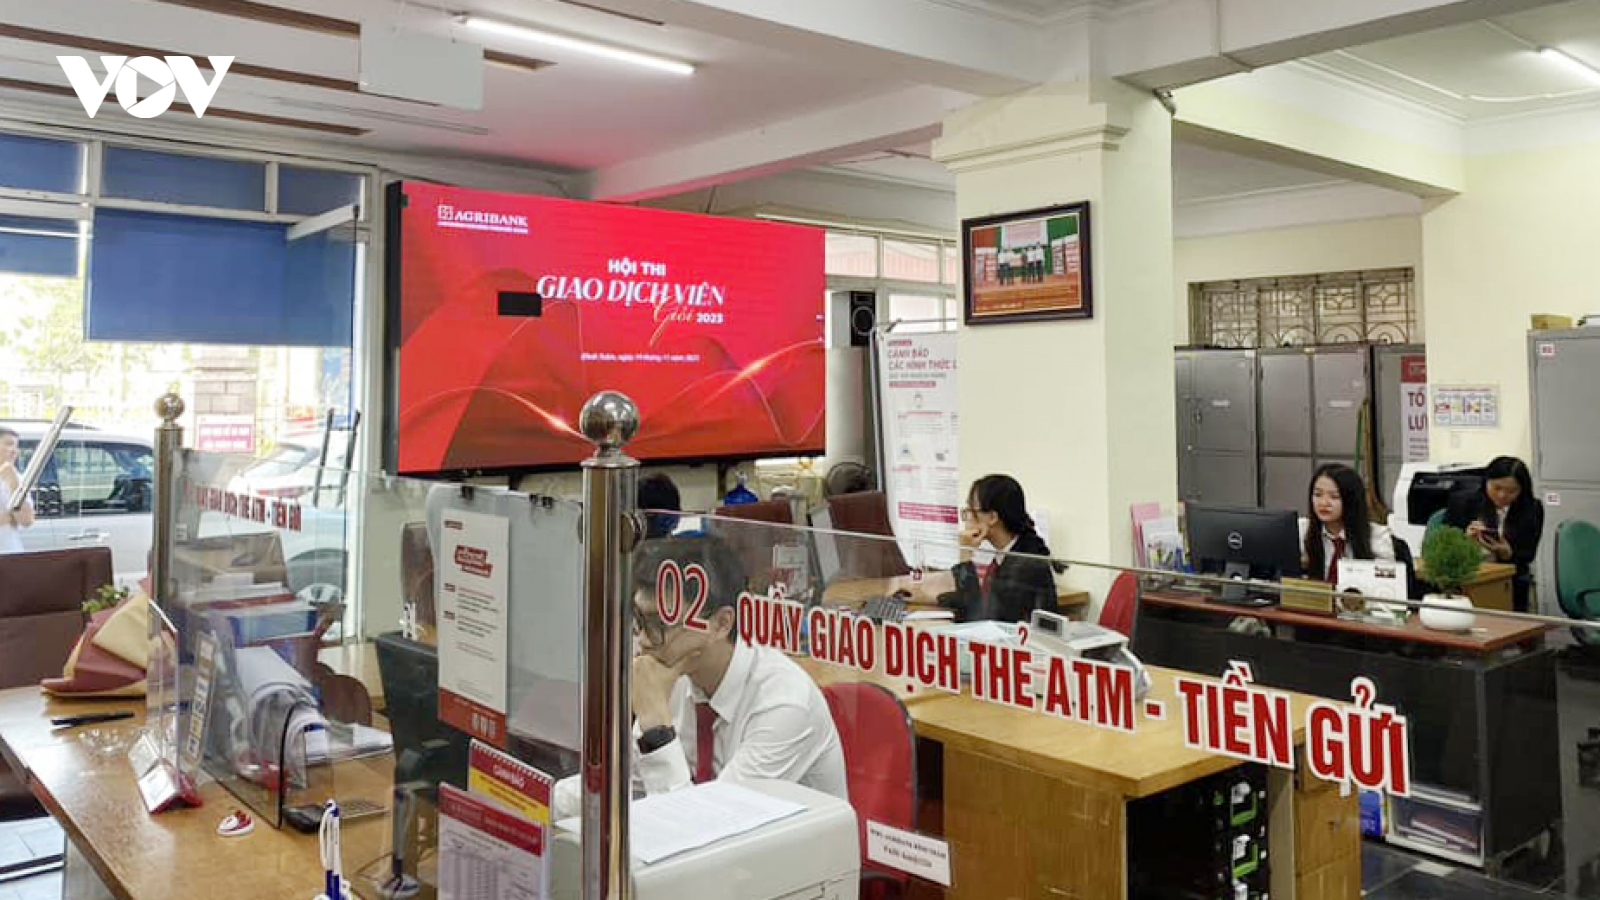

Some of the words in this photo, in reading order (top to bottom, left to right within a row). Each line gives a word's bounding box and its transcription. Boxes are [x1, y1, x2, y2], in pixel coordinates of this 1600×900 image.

[455, 211, 528, 227] AGRIBANK
[608, 257, 637, 277] HỘI
[641, 261, 667, 277] THI
[536, 275, 604, 301] GIAO
[606, 279, 671, 307] DỊCH
[672, 281, 725, 306] VIÊN
[696, 312, 724, 325] 2023
[657, 561, 709, 632] 02
[738, 584, 803, 654] QUẦY
[808, 607, 876, 671] GIAO
[882, 623, 960, 695] DỊCH
[968, 623, 1035, 710] THẺ
[1044, 654, 1135, 731] ATM
[1176, 662, 1292, 767] TIỀN
[1308, 681, 1408, 796] GỬI
